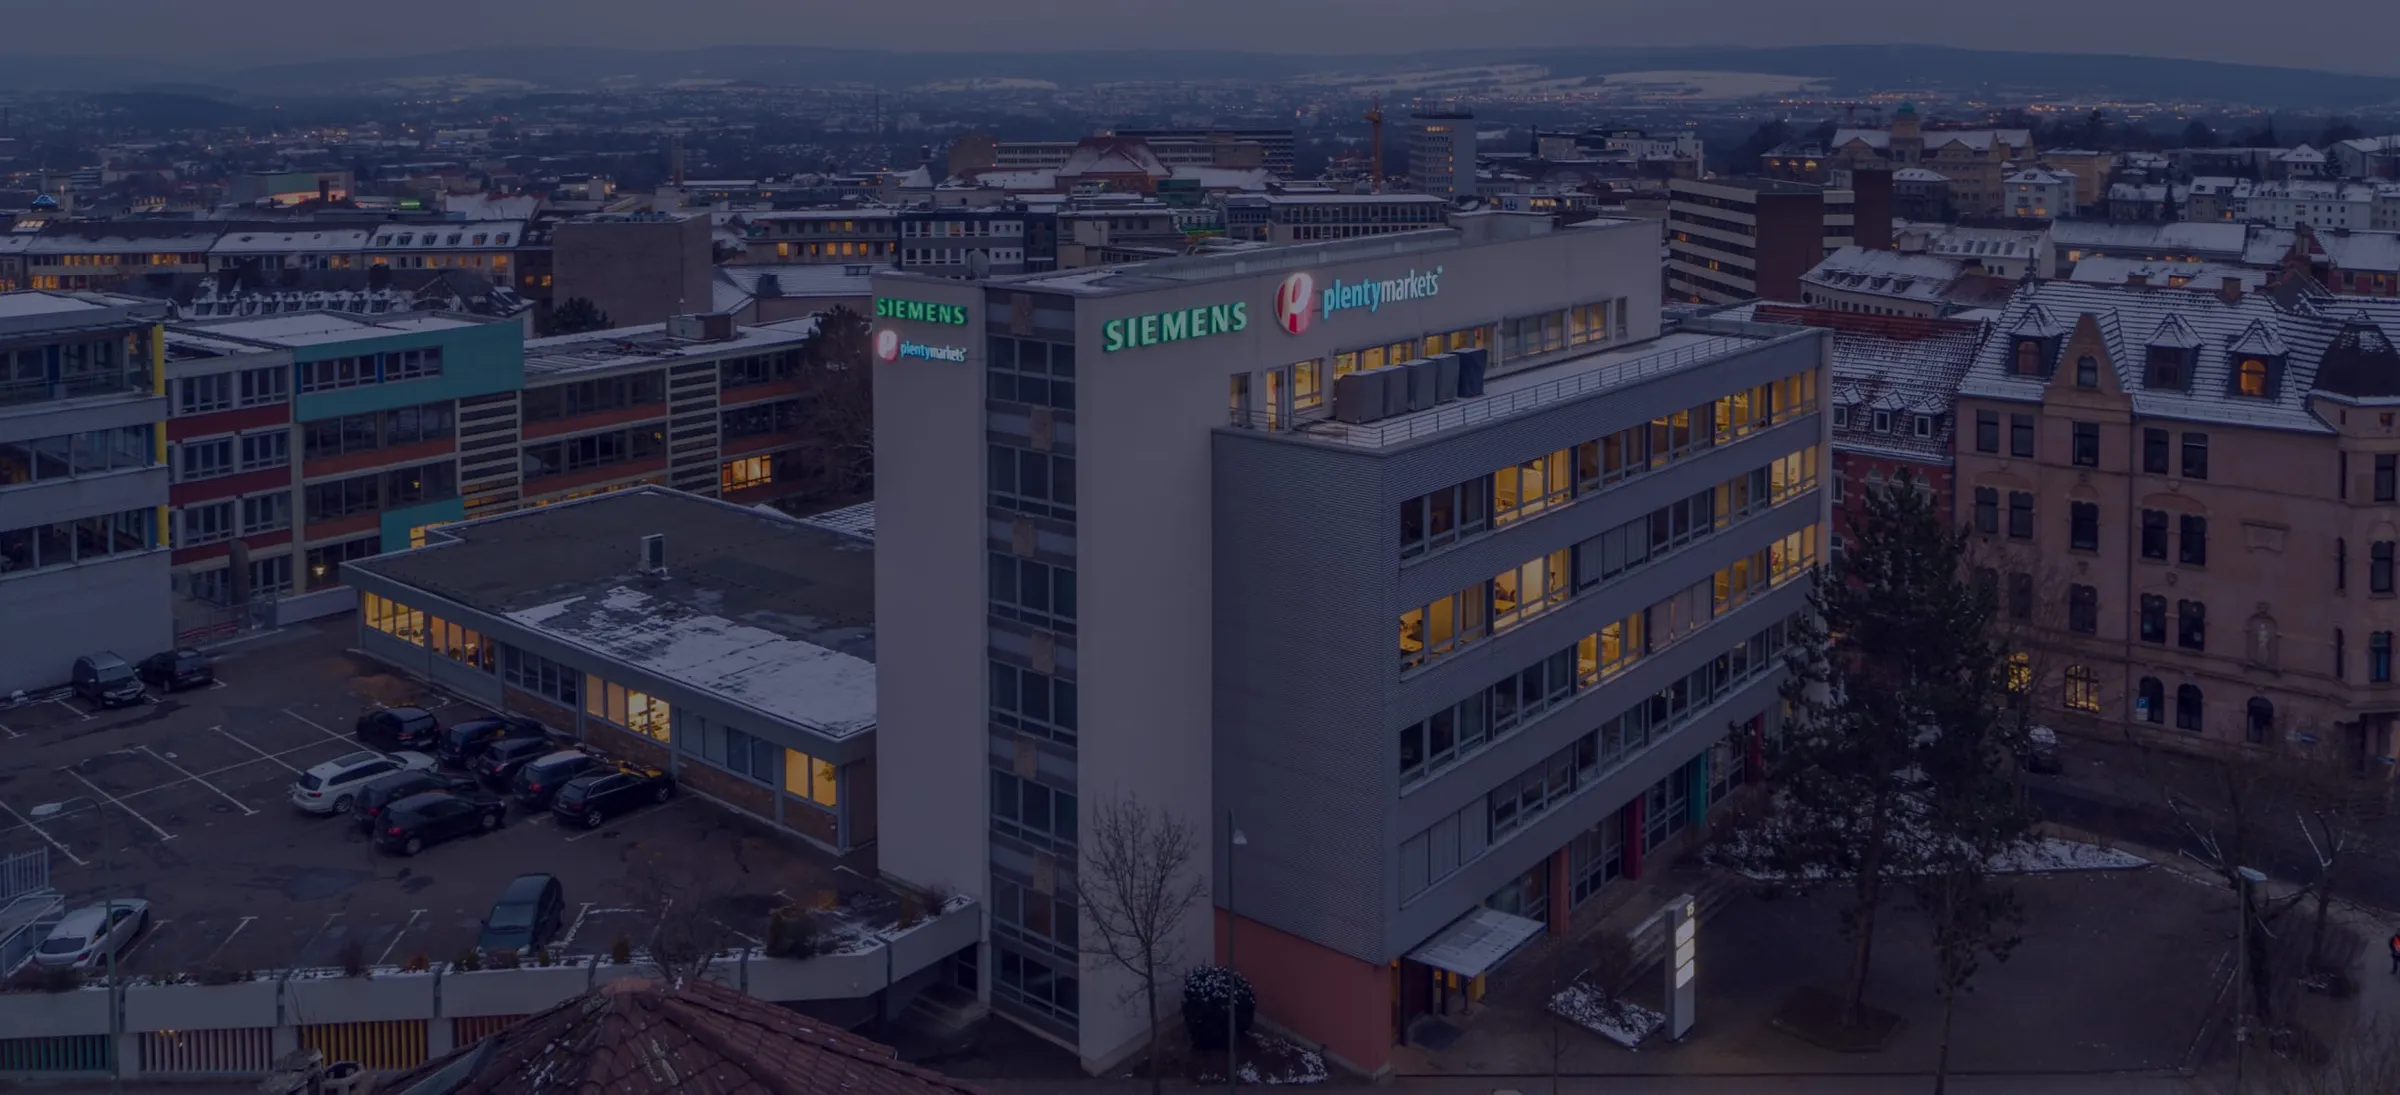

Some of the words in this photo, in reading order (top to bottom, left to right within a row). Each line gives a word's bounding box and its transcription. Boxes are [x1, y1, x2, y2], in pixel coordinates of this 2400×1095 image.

[876, 298, 966, 326] SIEMENS
[1322, 267, 1440, 319] plentymarkets
[1104, 301, 1248, 352] SIEMENS
